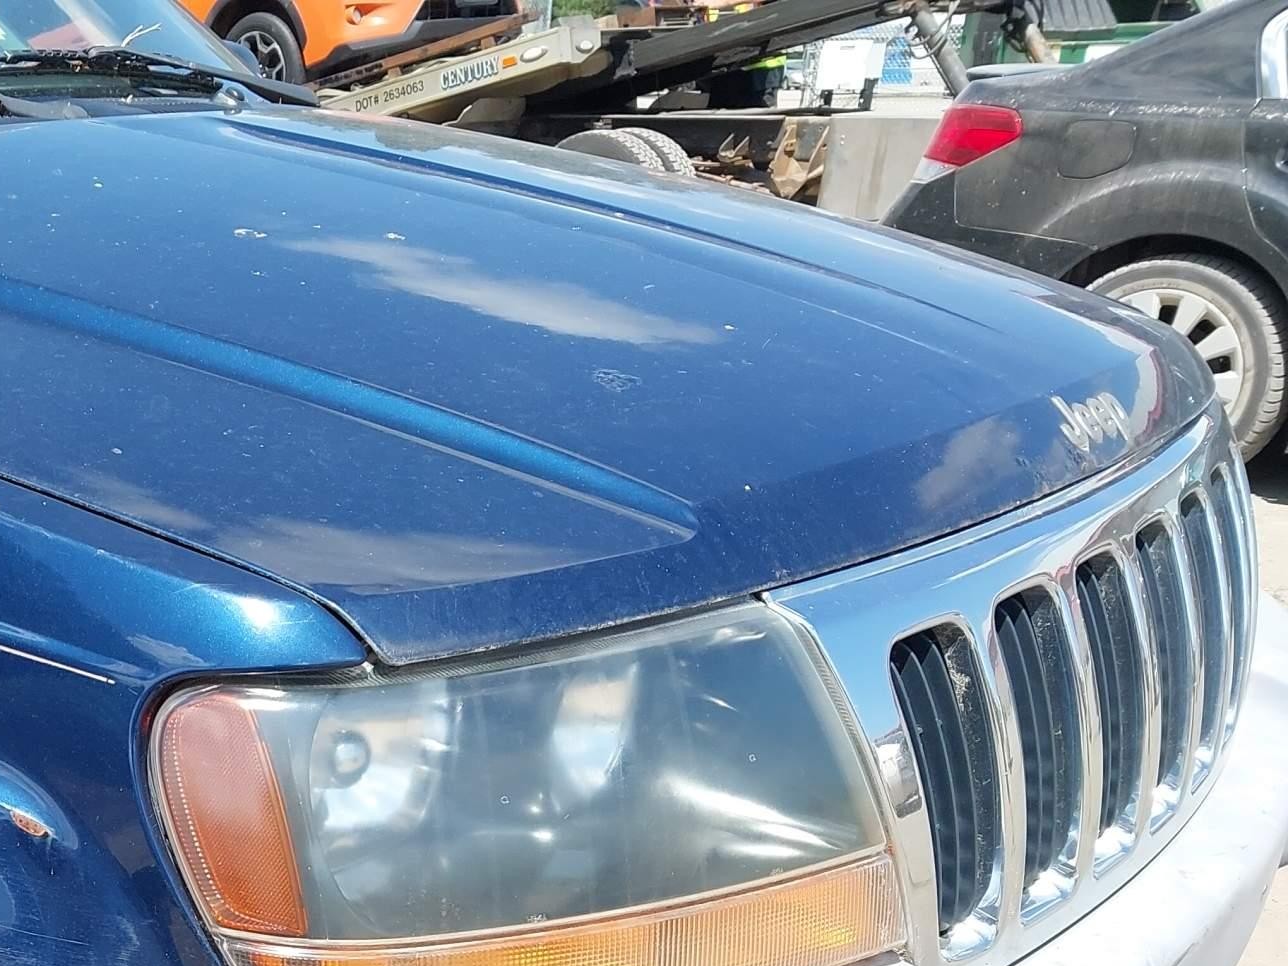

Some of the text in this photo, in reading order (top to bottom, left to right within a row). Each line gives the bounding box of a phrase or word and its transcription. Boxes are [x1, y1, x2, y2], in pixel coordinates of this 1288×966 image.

[440, 55, 500, 91] CENTURY
[355, 80, 425, 112] DOT# 2634063
[1049, 392, 1129, 454] Jeep
